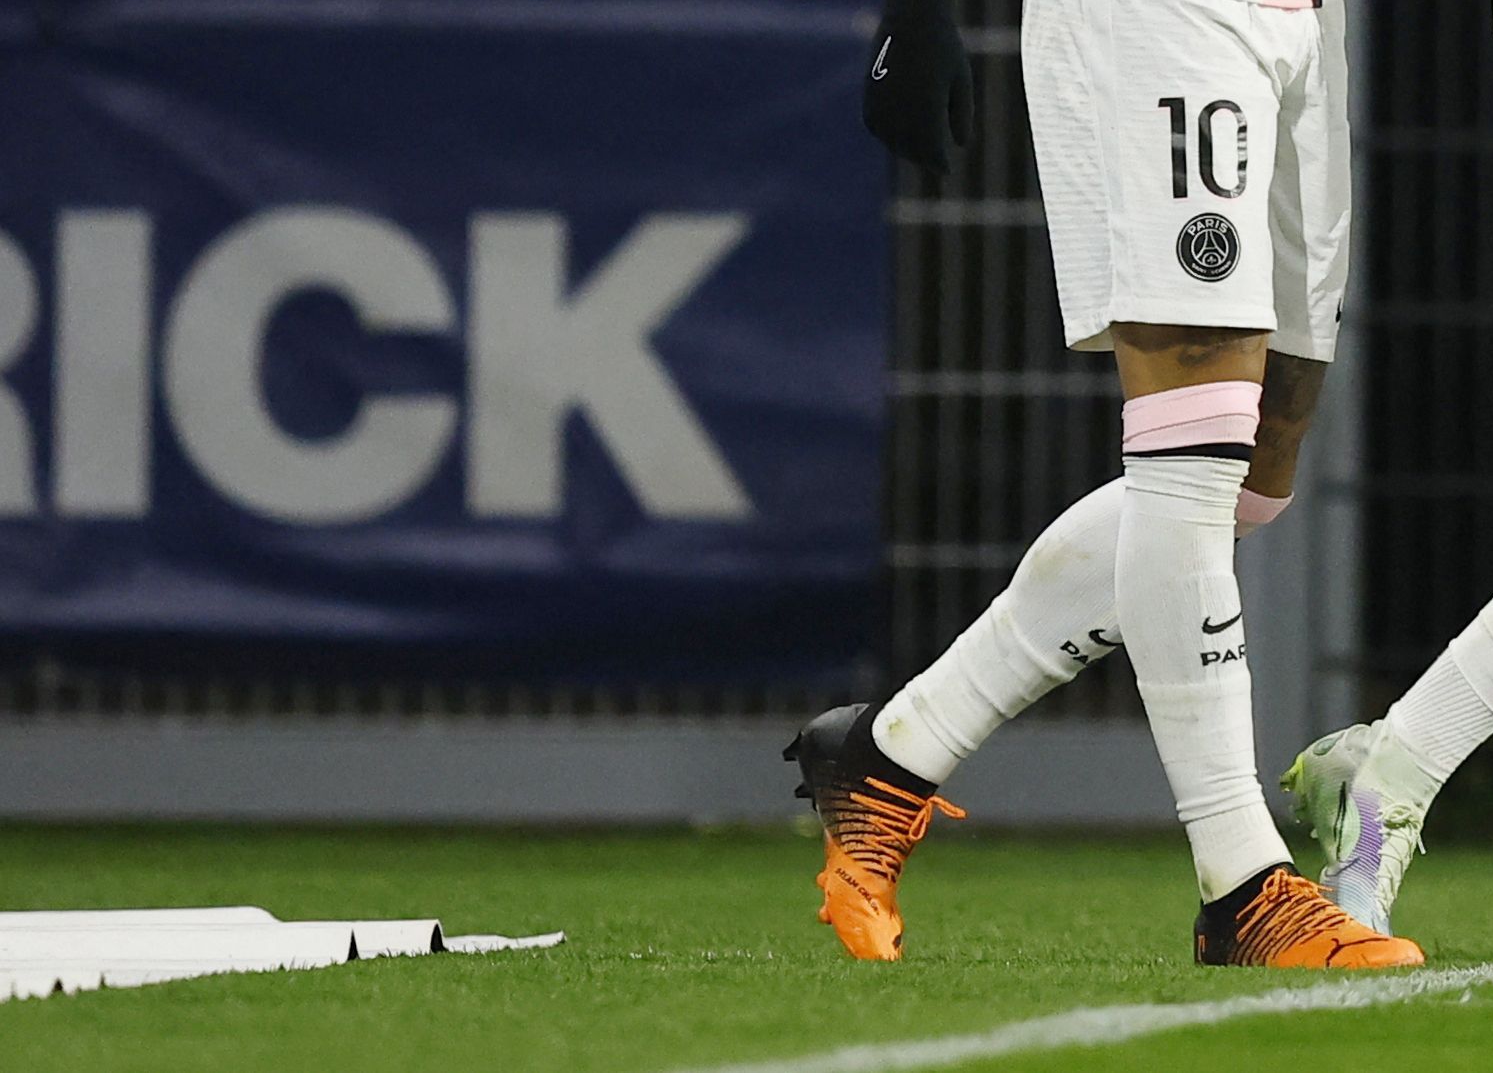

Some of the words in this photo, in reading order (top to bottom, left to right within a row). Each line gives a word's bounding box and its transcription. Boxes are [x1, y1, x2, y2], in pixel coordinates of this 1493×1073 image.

[1157, 97, 1248, 199] 10
[1187, 219, 1229, 236] PARIS
[0, 203, 756, 526] ICK
